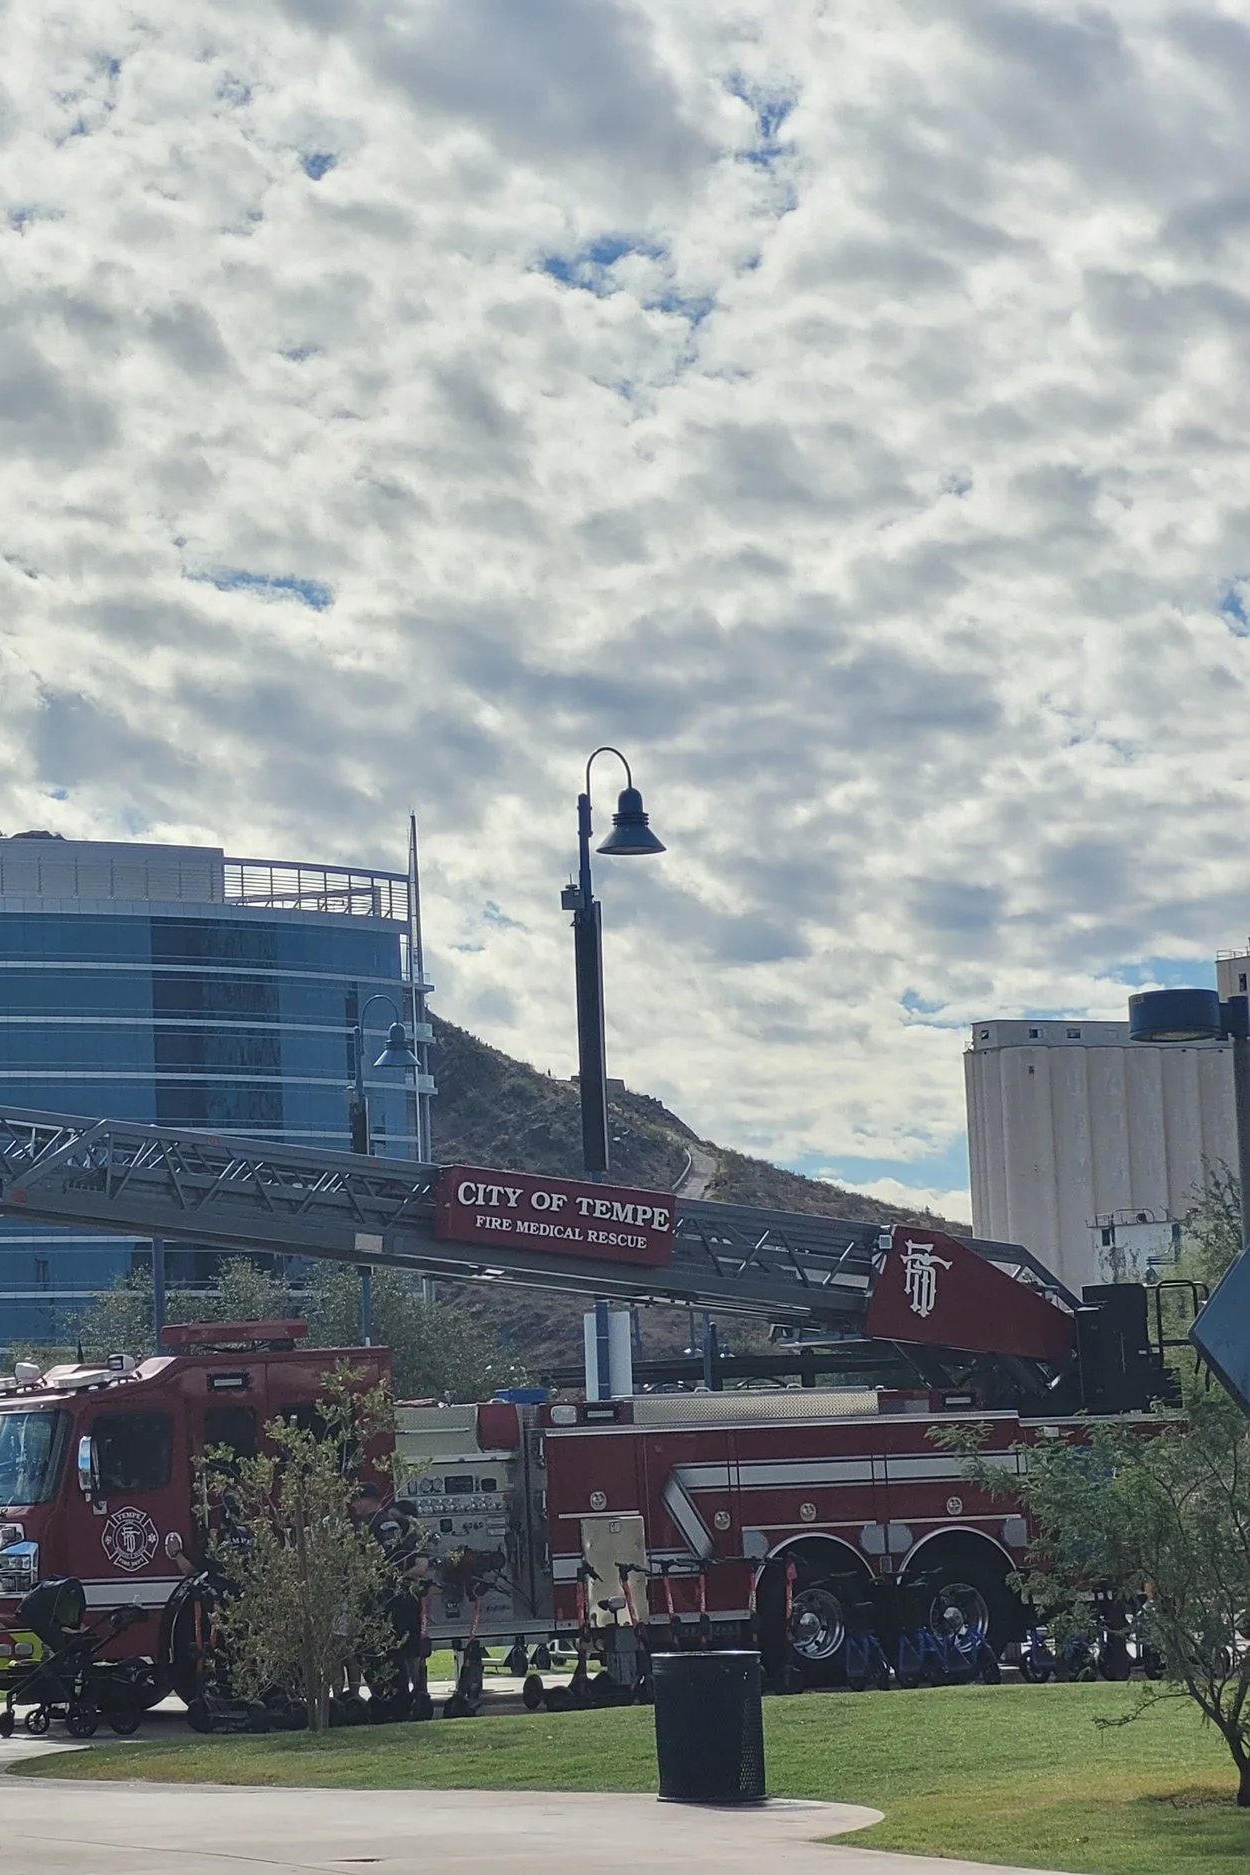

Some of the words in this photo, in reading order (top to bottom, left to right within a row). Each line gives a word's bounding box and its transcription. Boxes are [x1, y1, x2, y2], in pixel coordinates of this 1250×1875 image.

[458, 1181, 524, 1208] CITY
[531, 1191, 568, 1212] OF
[576, 1197, 671, 1232] TEMPE
[476, 1215, 512, 1231] FIRE
[516, 1220, 584, 1241] MEDICAL
[587, 1230, 648, 1249] RESCUE
[116, 1512, 141, 1520] TEMPE
